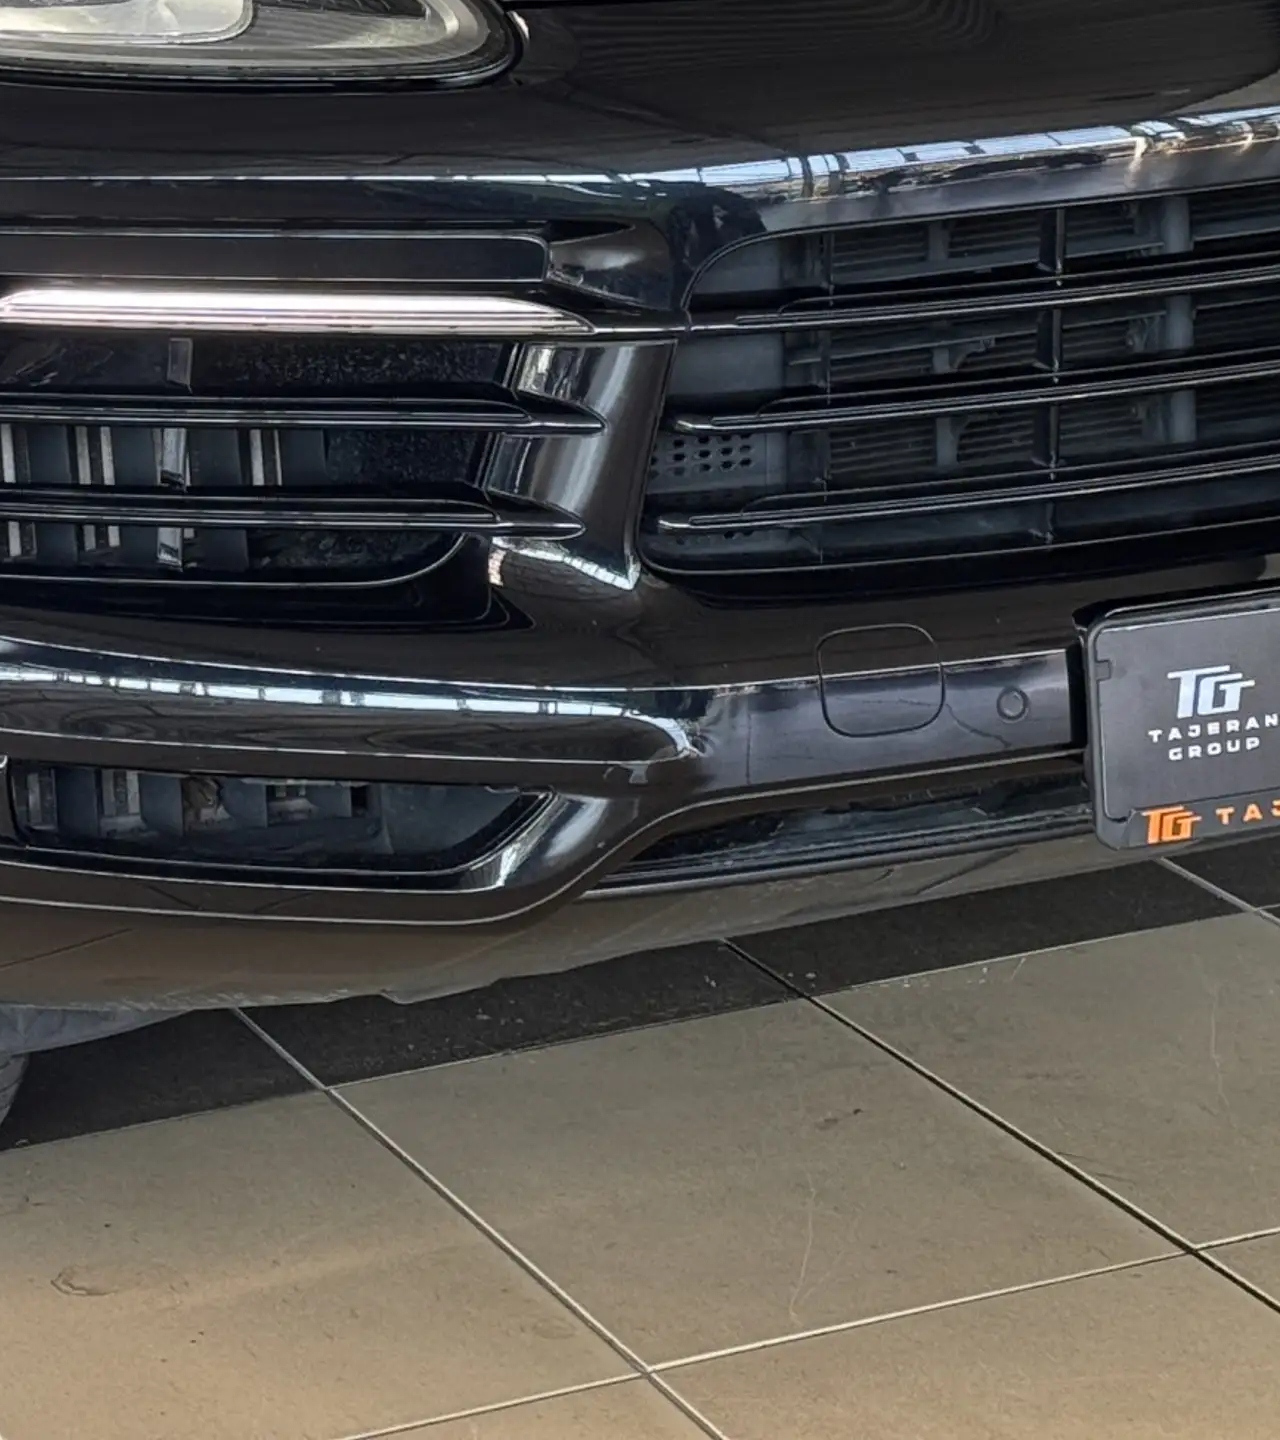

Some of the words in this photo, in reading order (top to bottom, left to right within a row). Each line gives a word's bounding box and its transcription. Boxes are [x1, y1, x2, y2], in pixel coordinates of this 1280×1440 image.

[1167, 664, 1256, 719] TG
[1148, 713, 1279, 743] TAJERAN
[1168, 737, 1261, 761] GROUP
